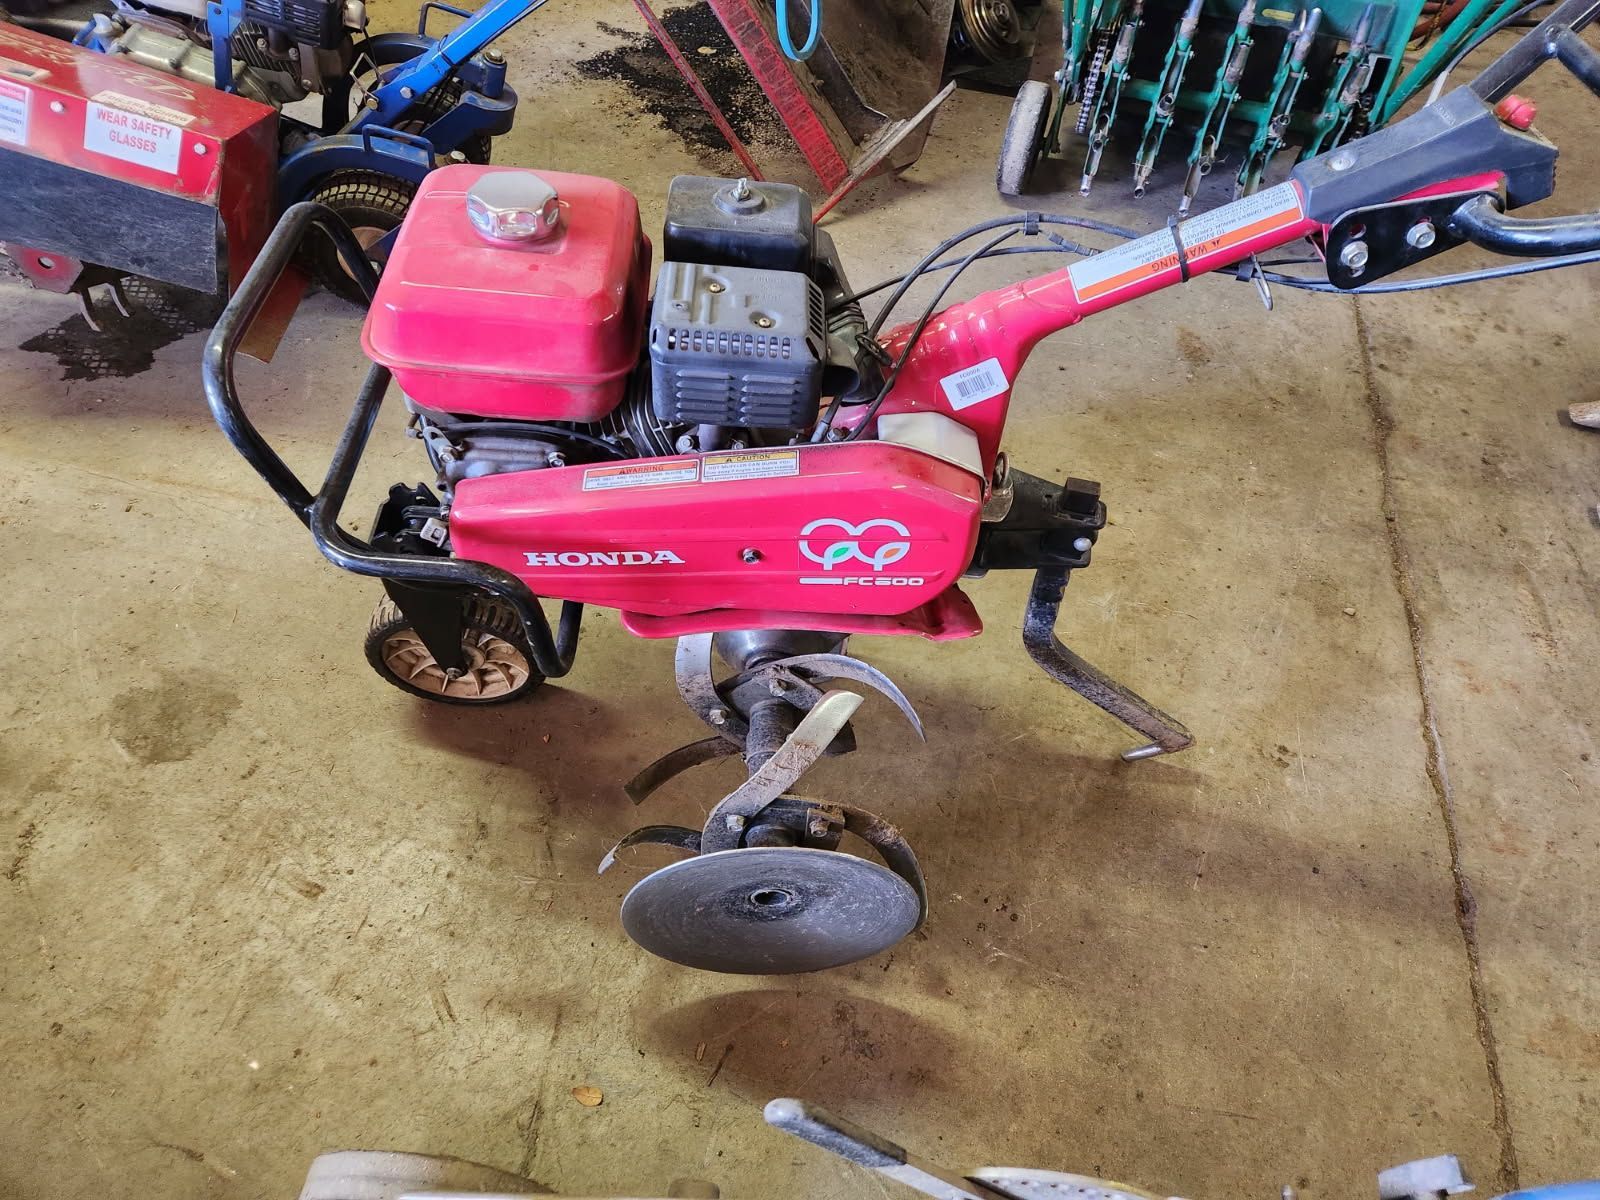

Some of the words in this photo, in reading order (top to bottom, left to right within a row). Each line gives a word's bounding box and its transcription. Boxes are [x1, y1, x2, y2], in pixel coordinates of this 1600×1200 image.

[96, 107, 128, 128] WEAR
[131, 118, 173, 140] SAFETY
[108, 130, 157, 154] GLASSES
[625, 464, 664, 474] WARNING
[523, 550, 685, 567] HONDA
